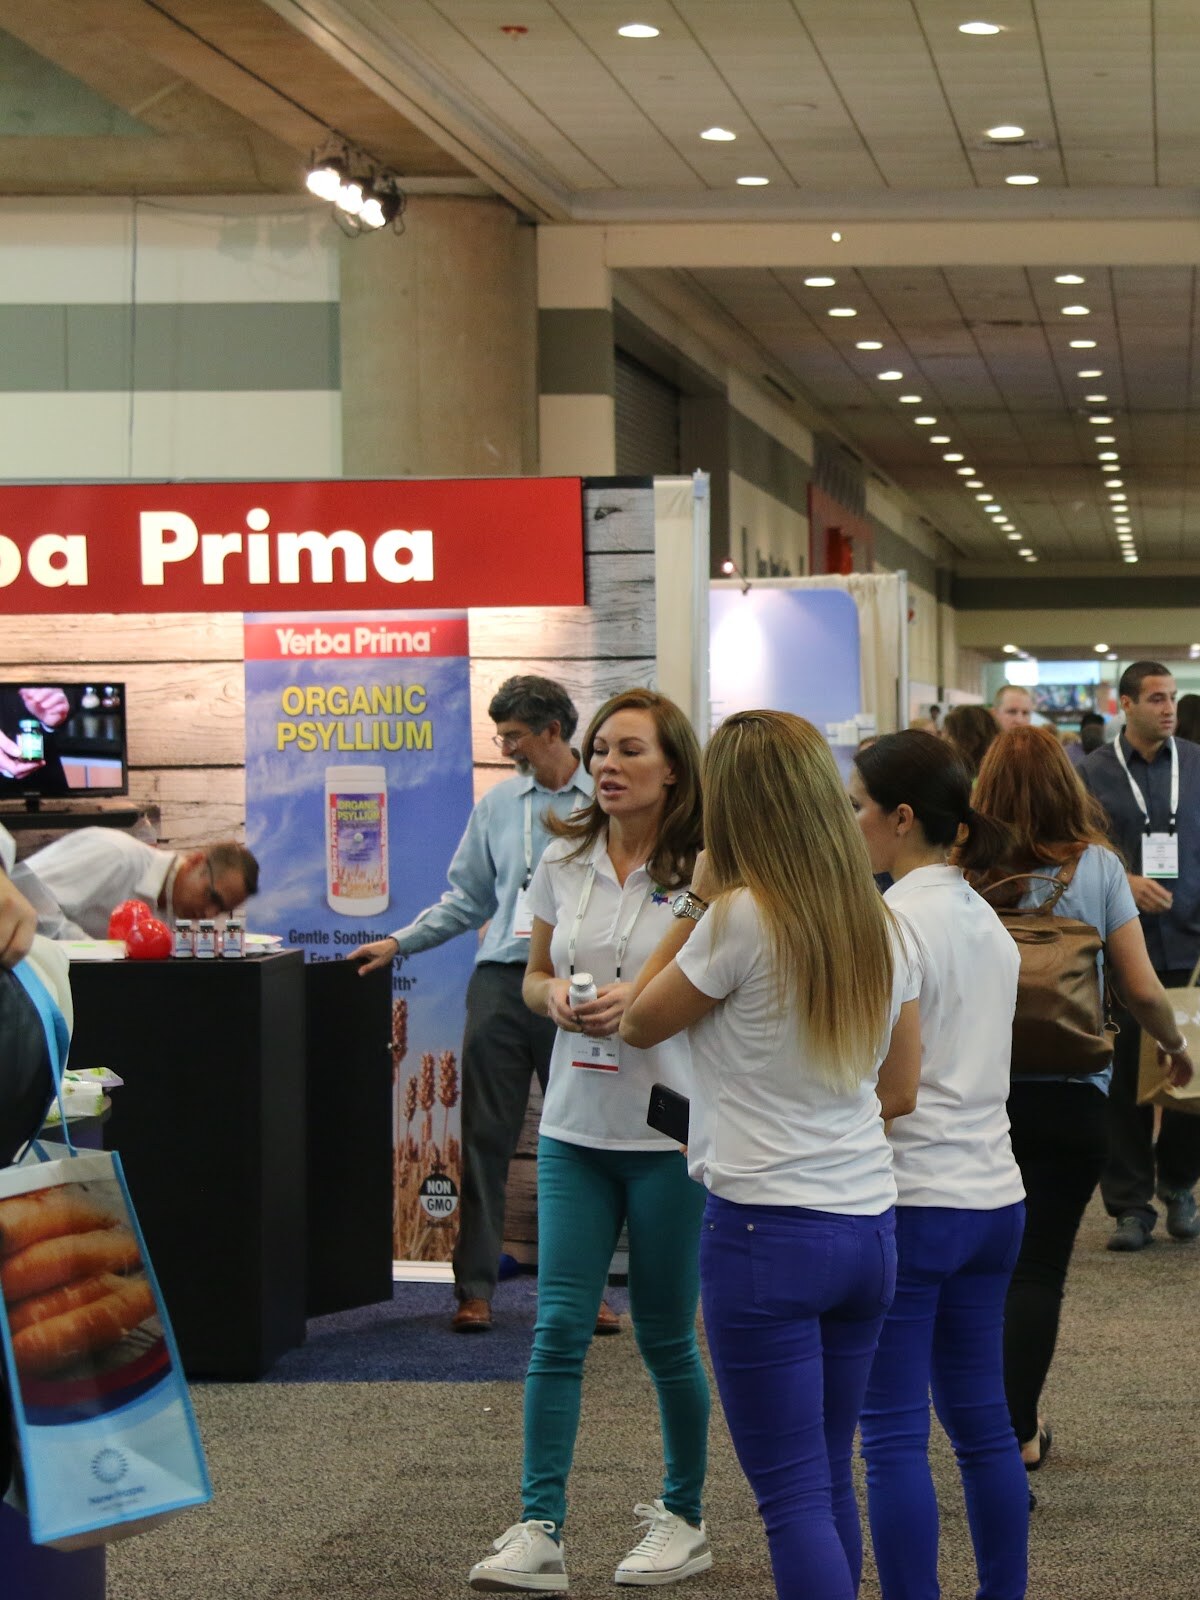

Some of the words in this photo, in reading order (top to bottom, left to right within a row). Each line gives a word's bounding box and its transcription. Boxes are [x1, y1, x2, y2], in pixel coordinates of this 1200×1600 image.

[139, 507, 435, 586] Prima
[276, 627, 350, 655] Yerba
[354, 626, 431, 654] Prima
[281, 683, 428, 717] ORGANIC
[276, 719, 434, 752] PSYLLIUM
[289, 929, 330, 945] Gentle
[333, 929, 389, 945] Soothin
[426, 1180, 452, 1194] NON
[427, 1198, 453, 1211] GMO
